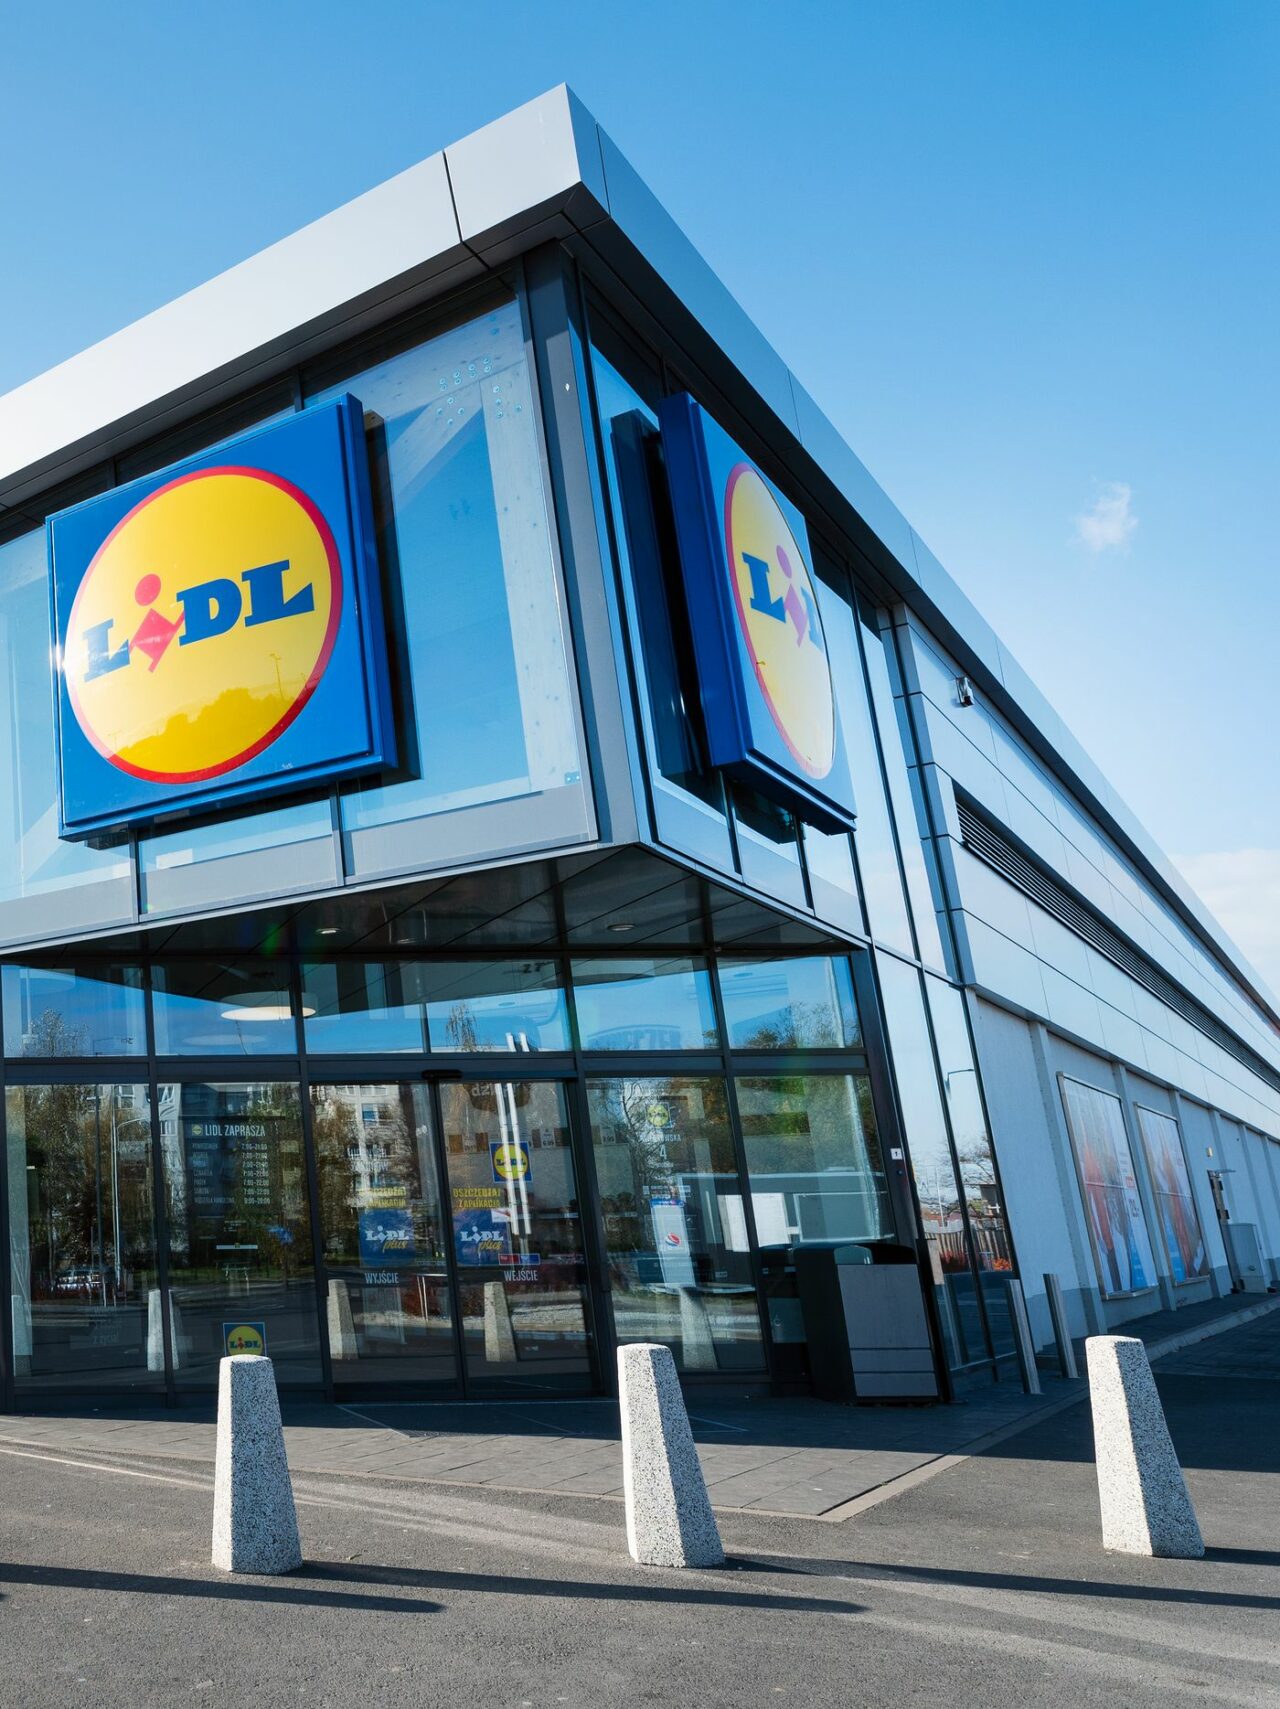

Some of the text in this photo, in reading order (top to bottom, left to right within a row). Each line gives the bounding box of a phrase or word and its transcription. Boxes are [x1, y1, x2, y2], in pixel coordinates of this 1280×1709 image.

[205, 1124, 266, 1137] LIDL ZAPRASZA
[382, 1239, 408, 1253] plus
[477, 1240, 503, 1256] plus
[364, 1270, 400, 1284] WYJŚCIE
[503, 1267, 538, 1282] WEJŚCIE
